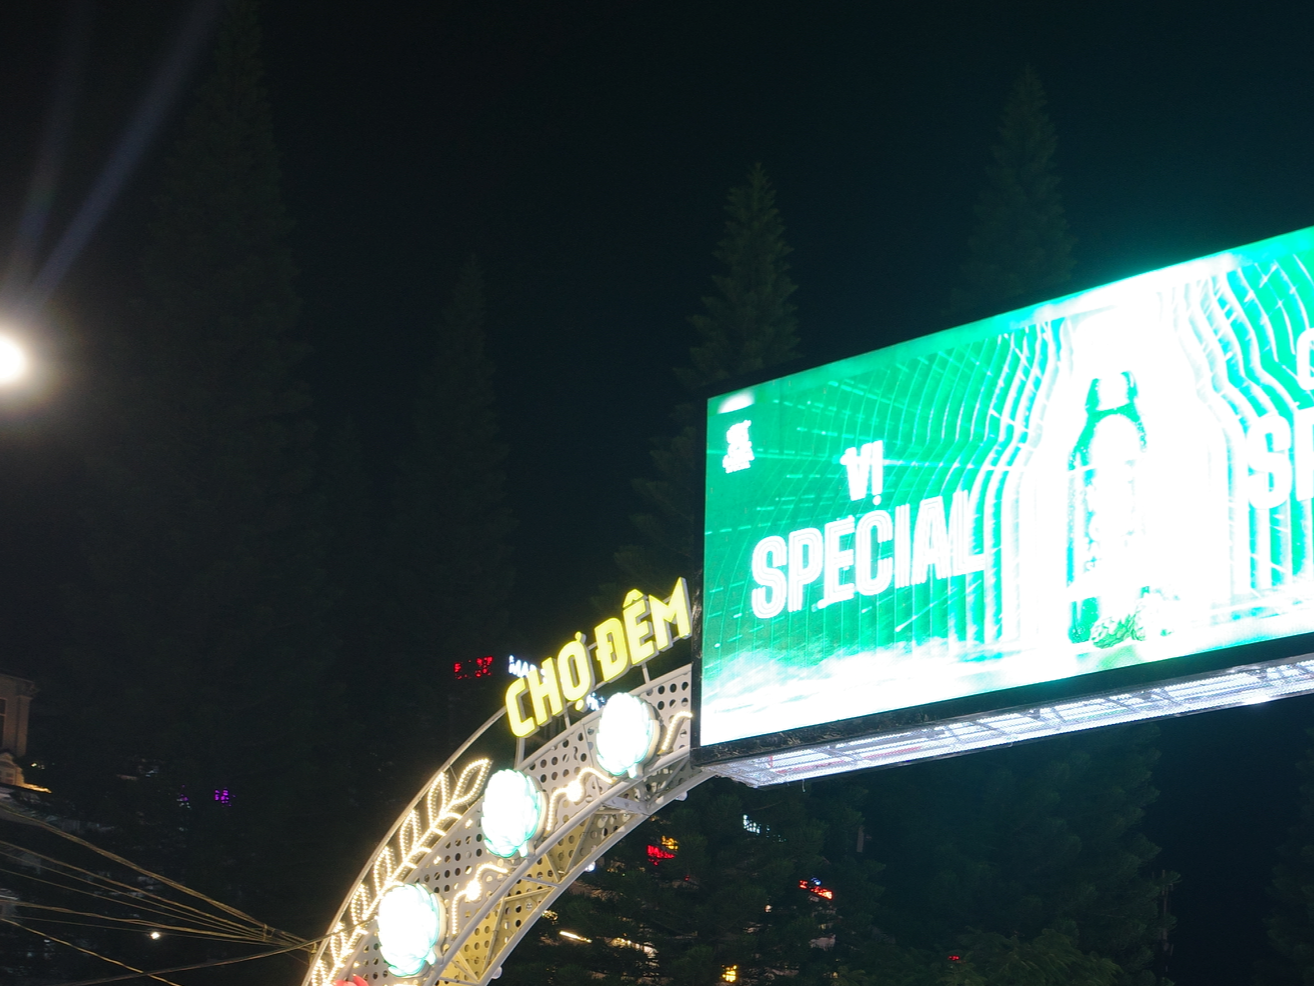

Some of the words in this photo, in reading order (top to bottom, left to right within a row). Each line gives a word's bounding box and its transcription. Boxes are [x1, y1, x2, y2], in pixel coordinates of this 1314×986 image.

[843, 440, 885, 505] VỊ
[751, 490, 986, 619] SPECIAL
[505, 631, 593, 737] CHỢ
[594, 576, 692, 683] ĐÊM
